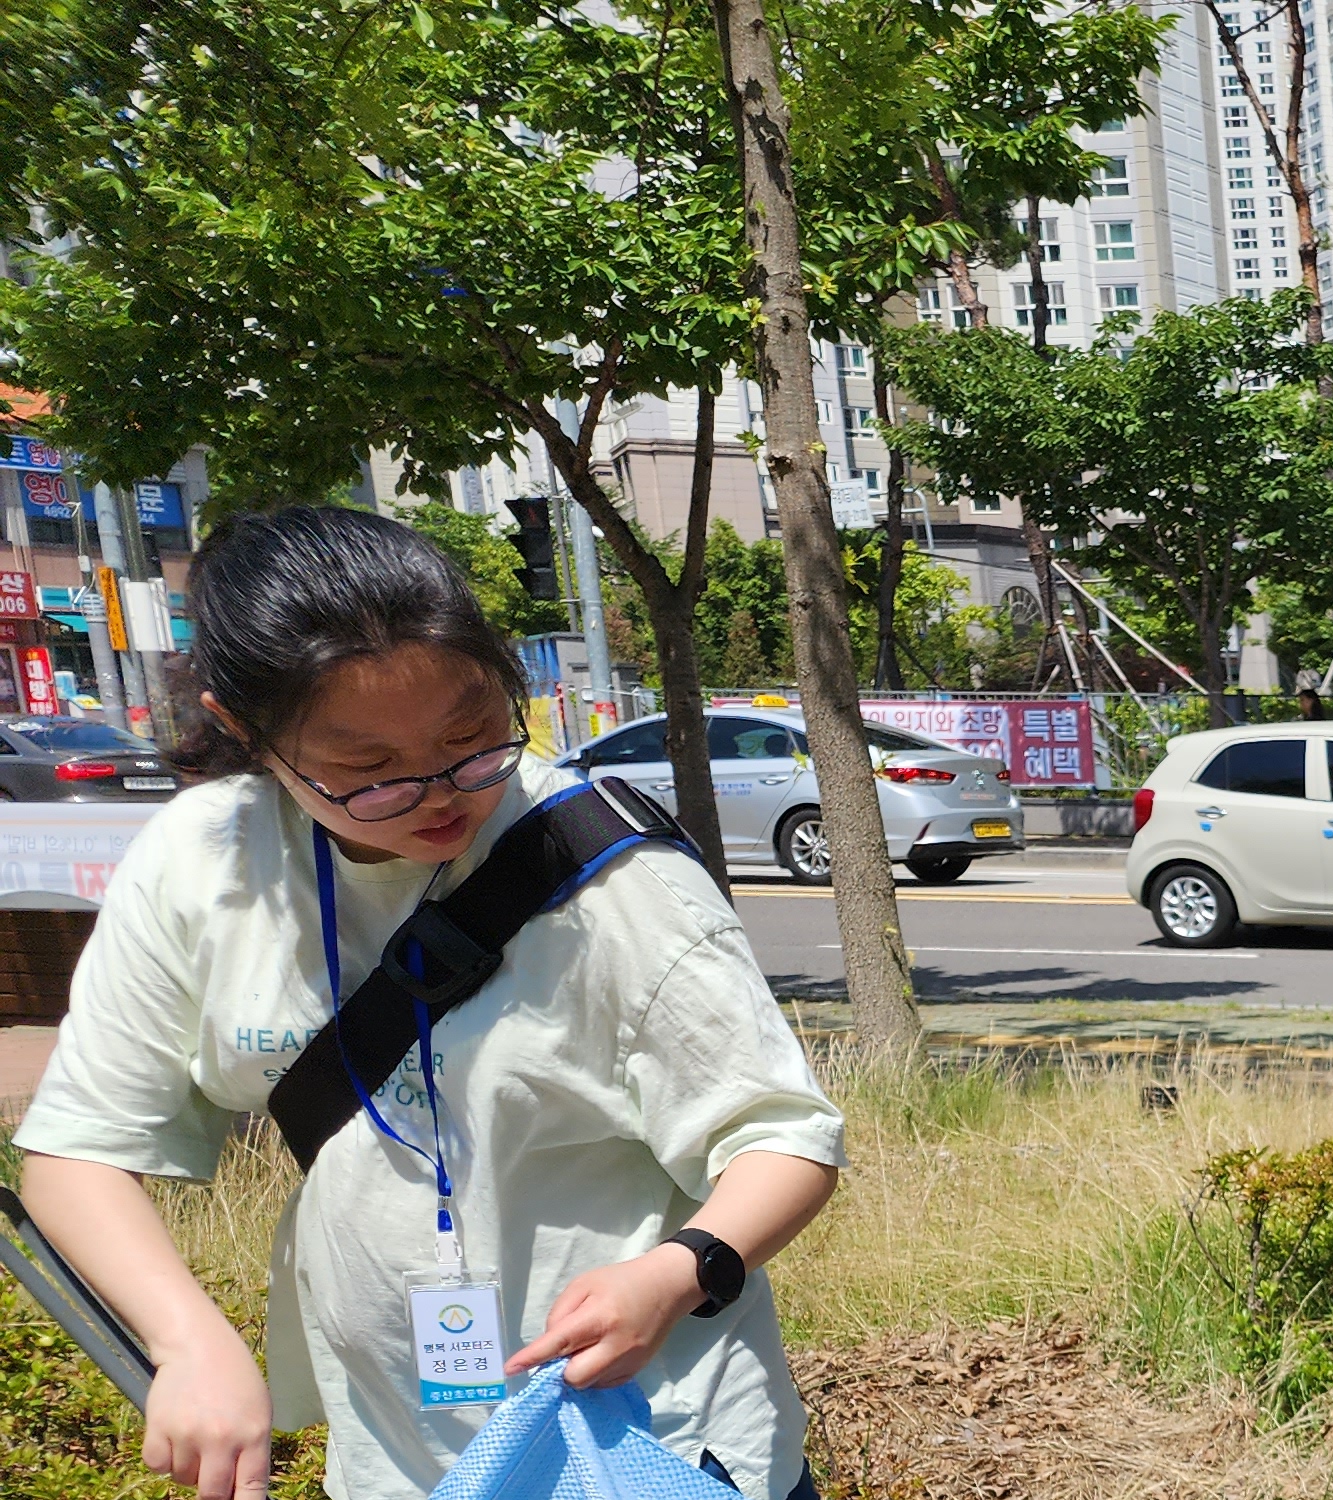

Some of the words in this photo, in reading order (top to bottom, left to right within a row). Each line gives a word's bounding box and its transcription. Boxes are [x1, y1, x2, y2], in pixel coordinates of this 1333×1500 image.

[1022, 708, 1079, 744] 특별
[1024, 746, 1081, 780] 혜택
[449, 1340, 494, 1352] 서포터즈
[432, 1356, 489, 1374] 정은경
